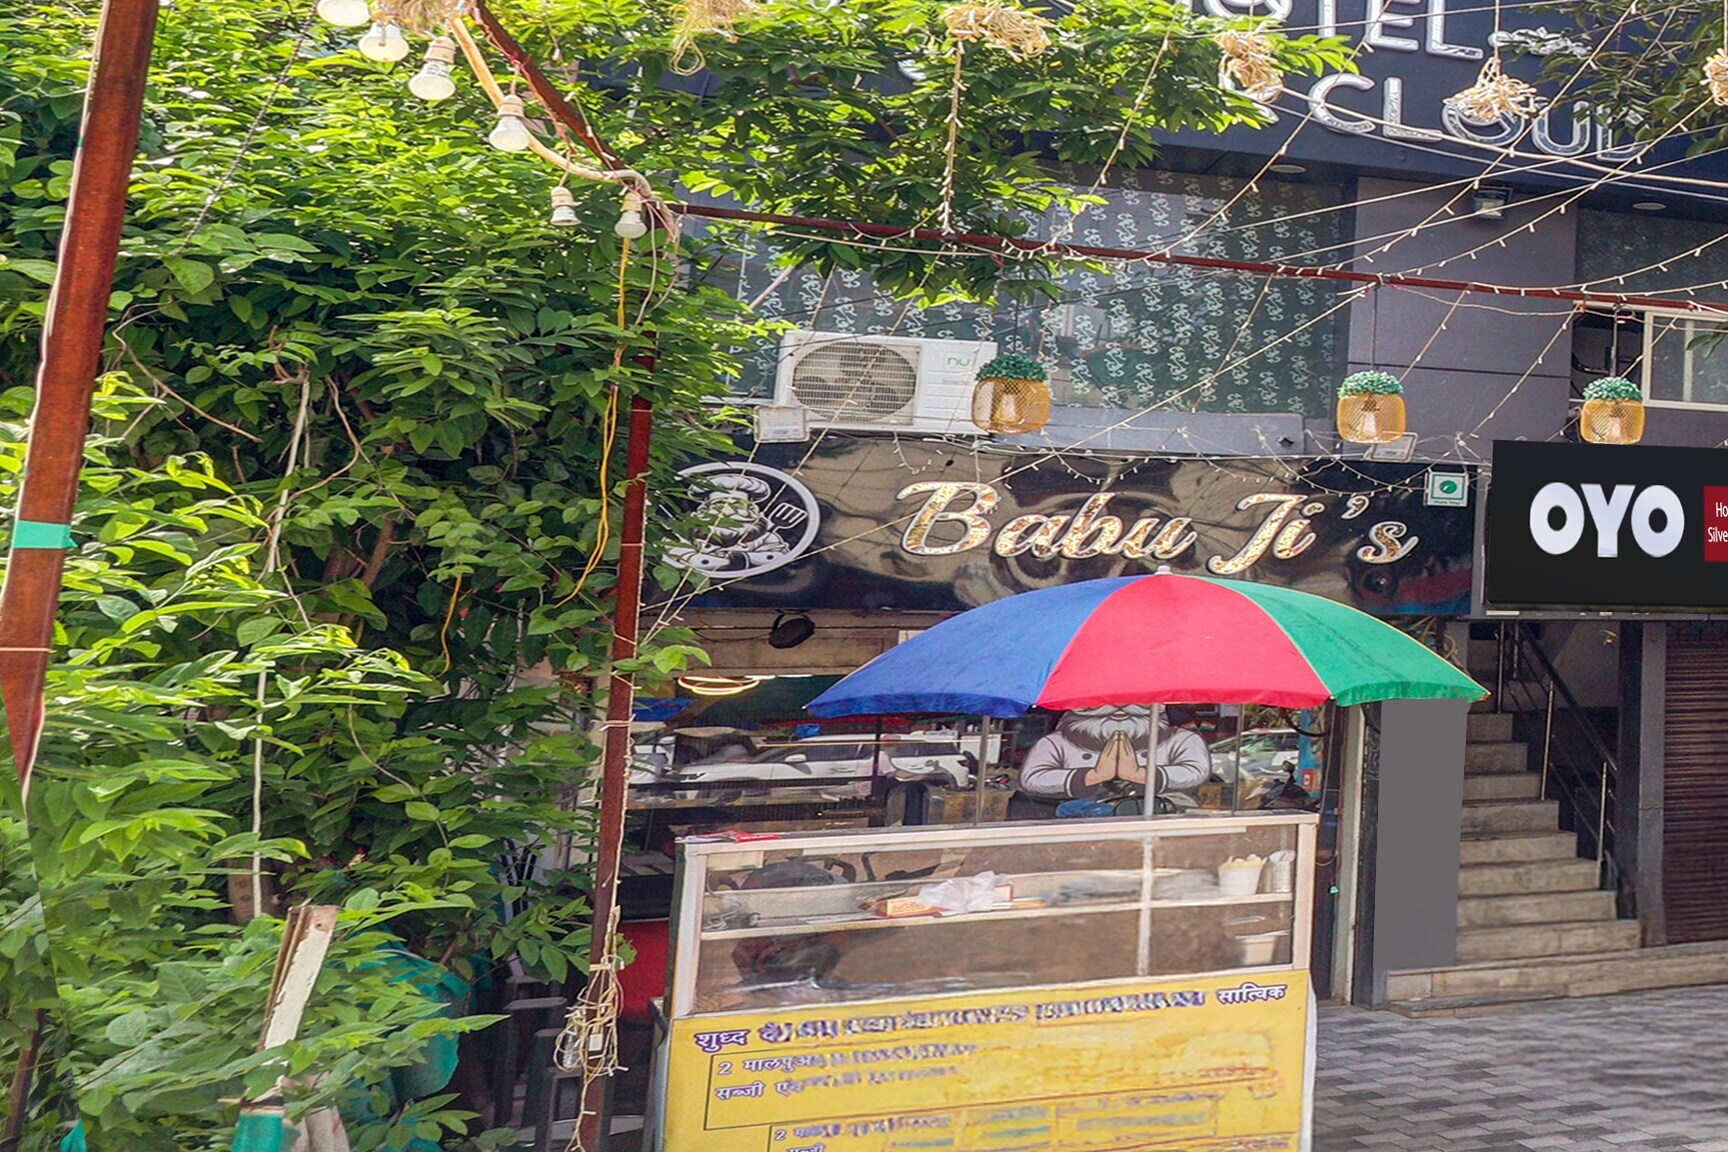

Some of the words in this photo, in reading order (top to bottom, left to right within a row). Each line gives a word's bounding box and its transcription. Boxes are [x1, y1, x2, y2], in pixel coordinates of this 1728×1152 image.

[896, 481, 1198, 560] Babu
[1206, 491, 1418, 576] Ji's
[1529, 481, 1685, 558] OYO
[717, 1062, 732, 1075] 2
